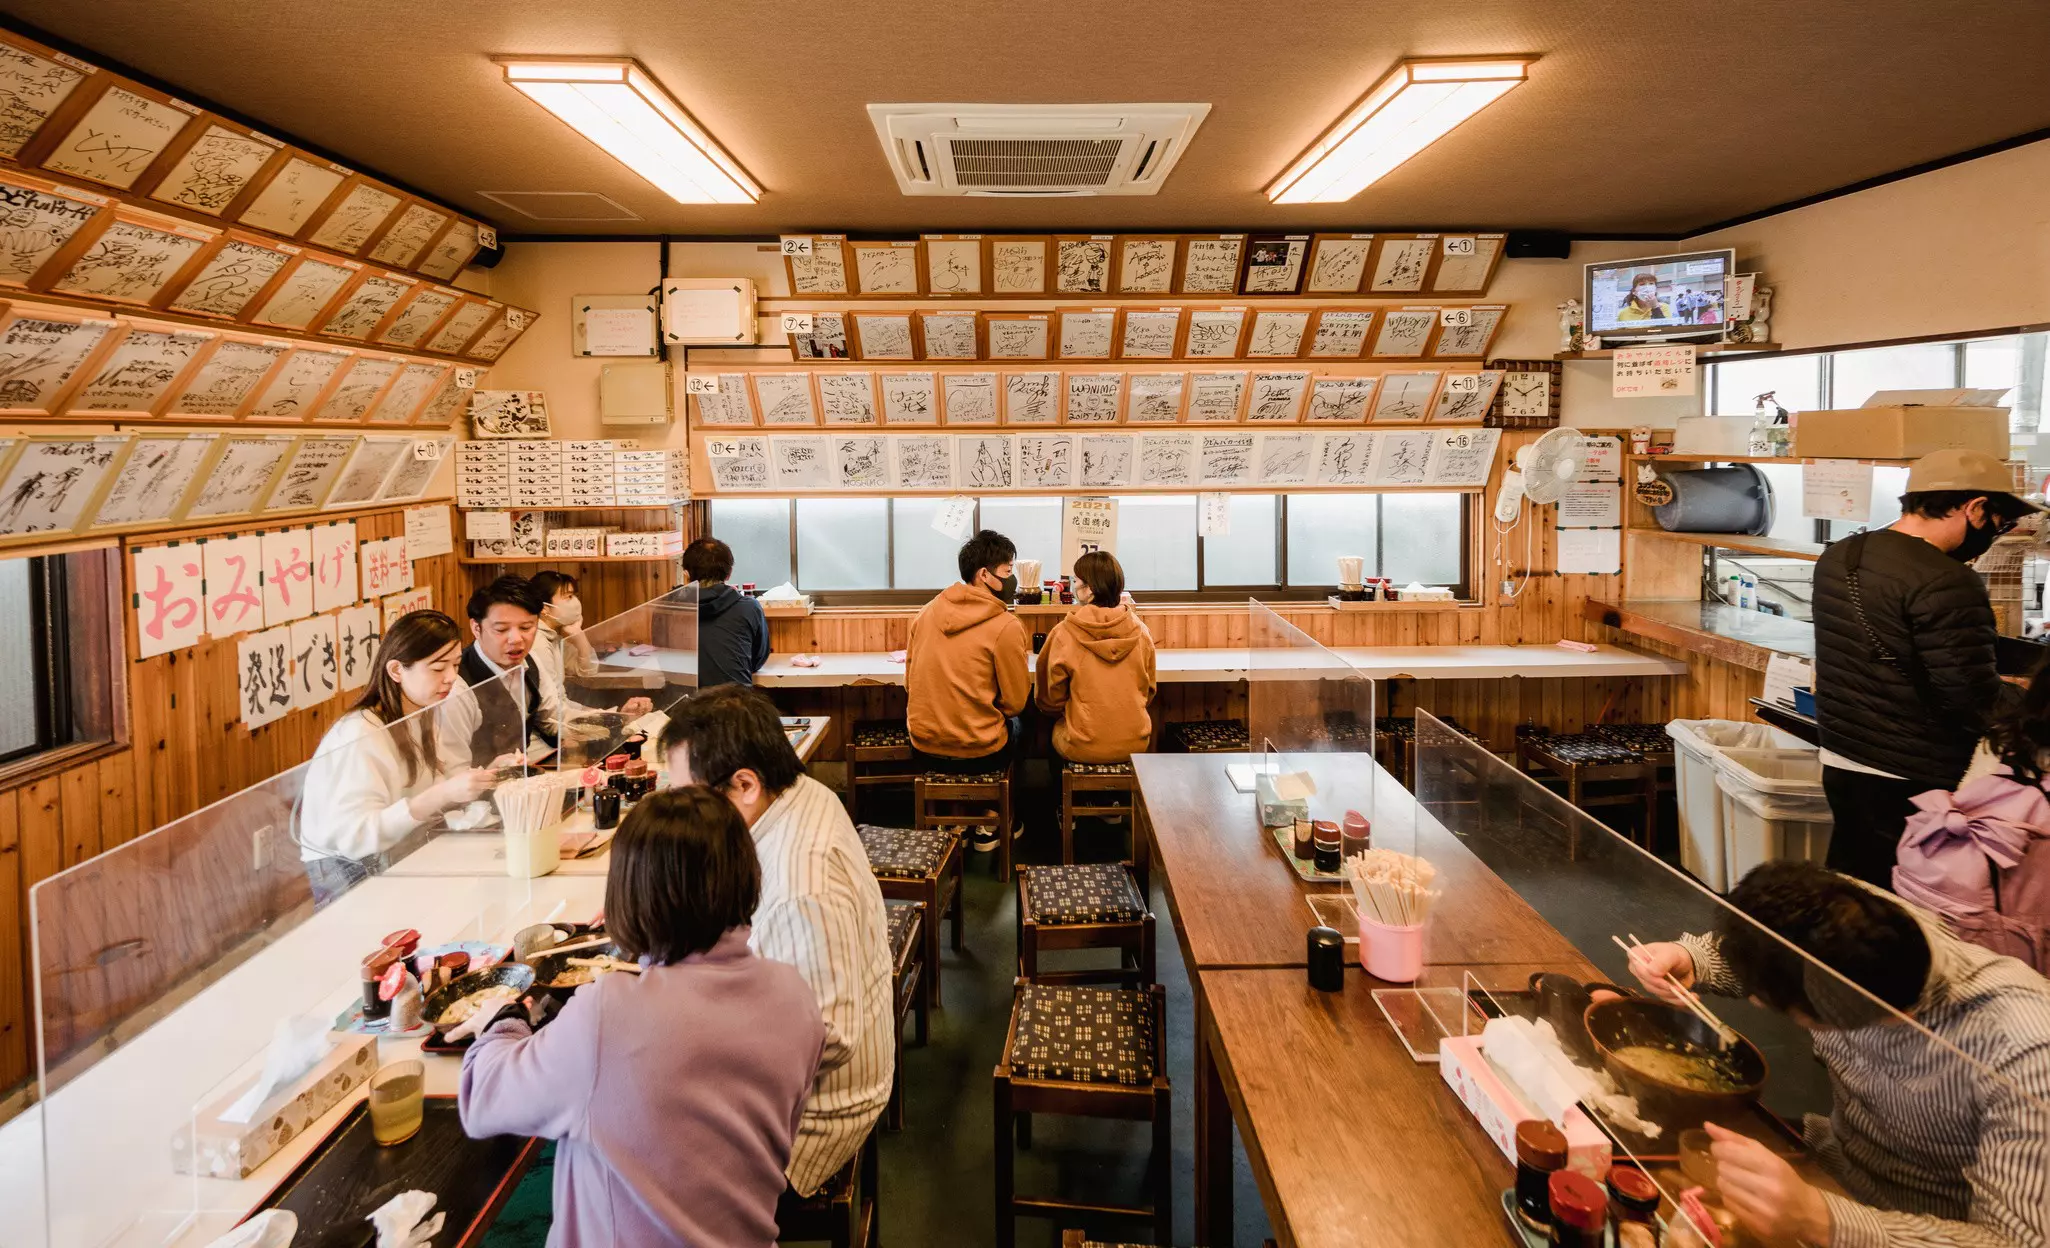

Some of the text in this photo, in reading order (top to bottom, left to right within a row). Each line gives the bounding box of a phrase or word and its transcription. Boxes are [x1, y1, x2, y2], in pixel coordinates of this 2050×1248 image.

[1072, 501, 1111, 510] 2021
[144, 540, 351, 641] おみやげ
[244, 620, 380, 715] 発送できます
